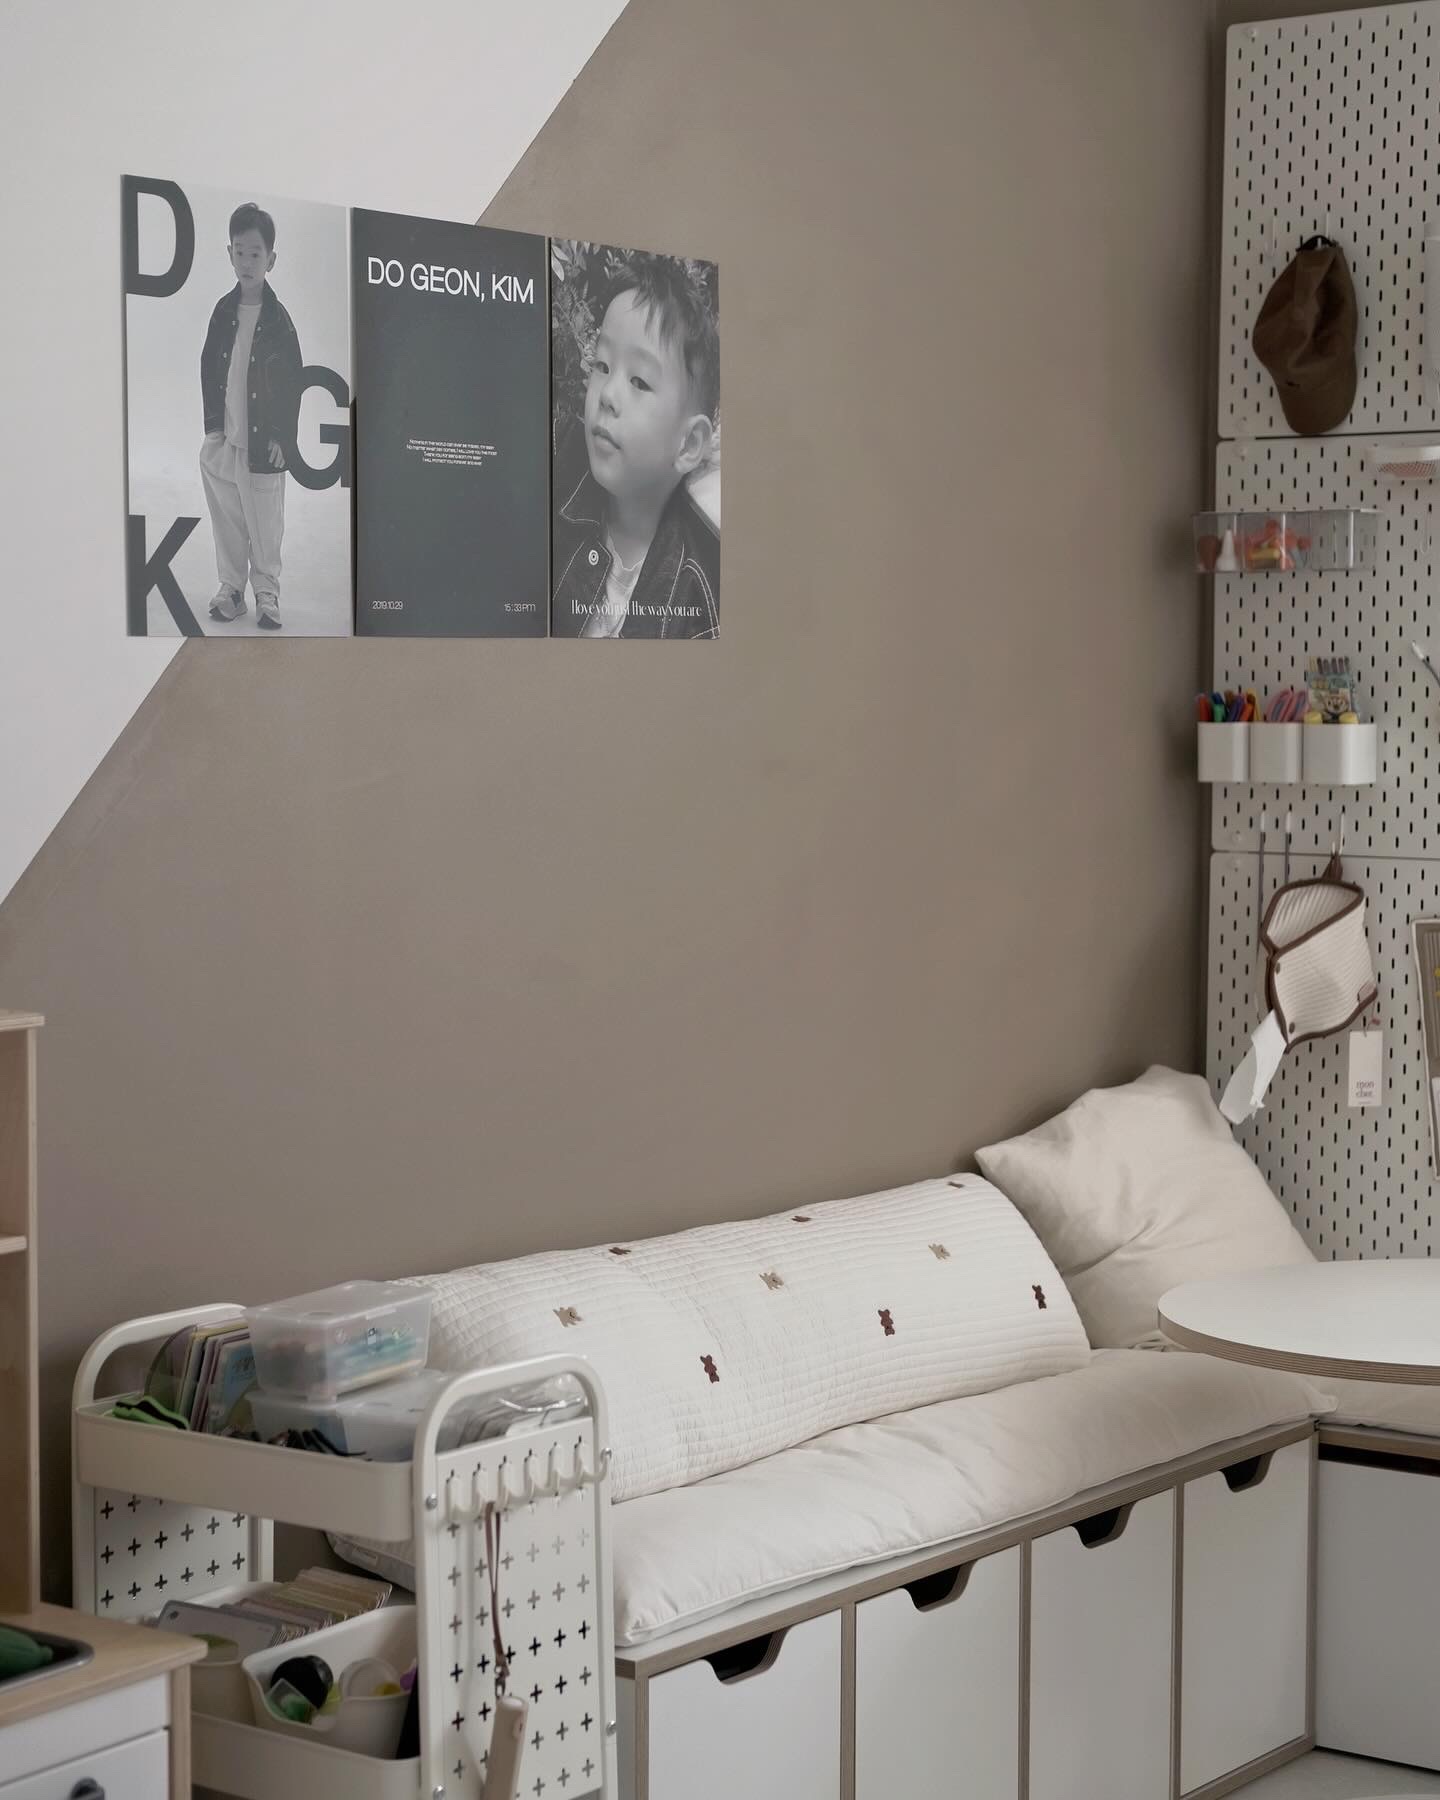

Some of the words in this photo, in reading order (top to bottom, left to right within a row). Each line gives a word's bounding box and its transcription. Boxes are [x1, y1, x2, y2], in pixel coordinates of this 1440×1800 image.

[122, 174, 195, 297] D
[368, 256, 405, 287] DO
[410, 263, 485, 302] GEON,
[492, 273, 534, 304] KIM
[288, 365, 352, 490] G
[127, 514, 206, 636] K
